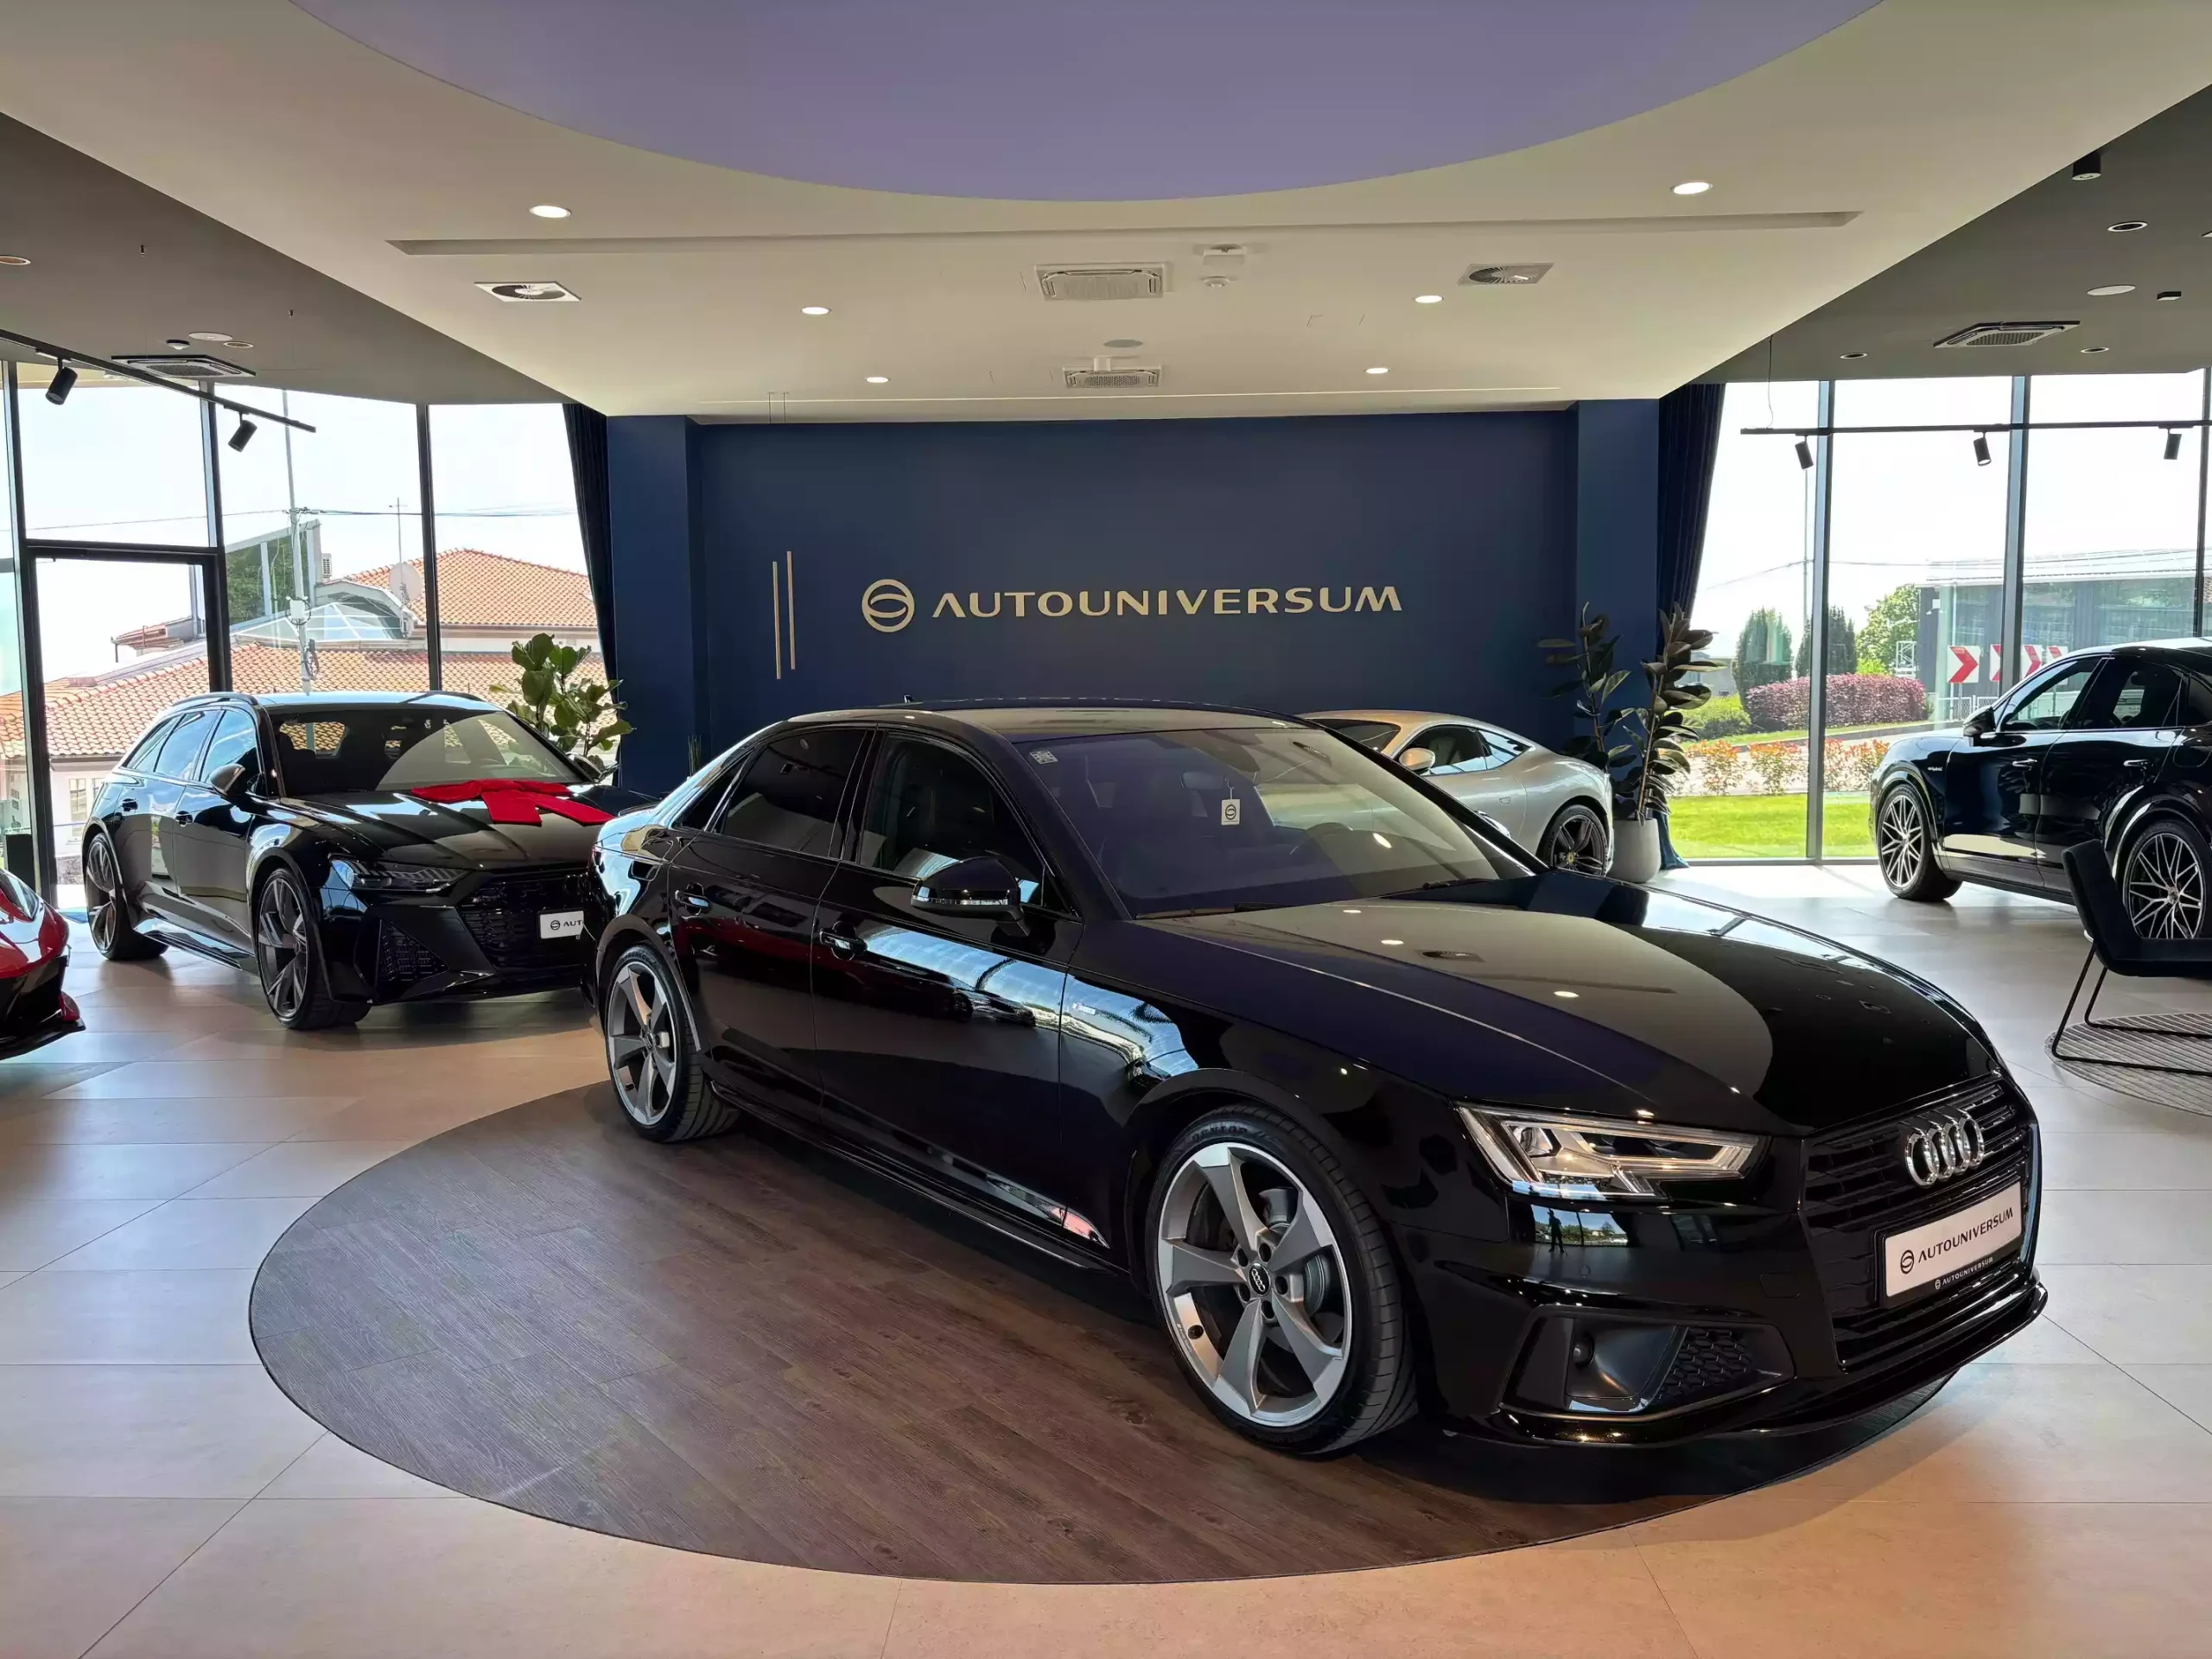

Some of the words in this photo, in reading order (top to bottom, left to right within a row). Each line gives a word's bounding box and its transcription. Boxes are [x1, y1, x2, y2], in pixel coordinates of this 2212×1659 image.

[932, 586, 1402, 617] AUTOUNIVERSUM
[1918, 1207, 2013, 1262] AUTOUNIVERSUM
[1942, 1257, 1993, 1285] AUTOUNIVERSUM
